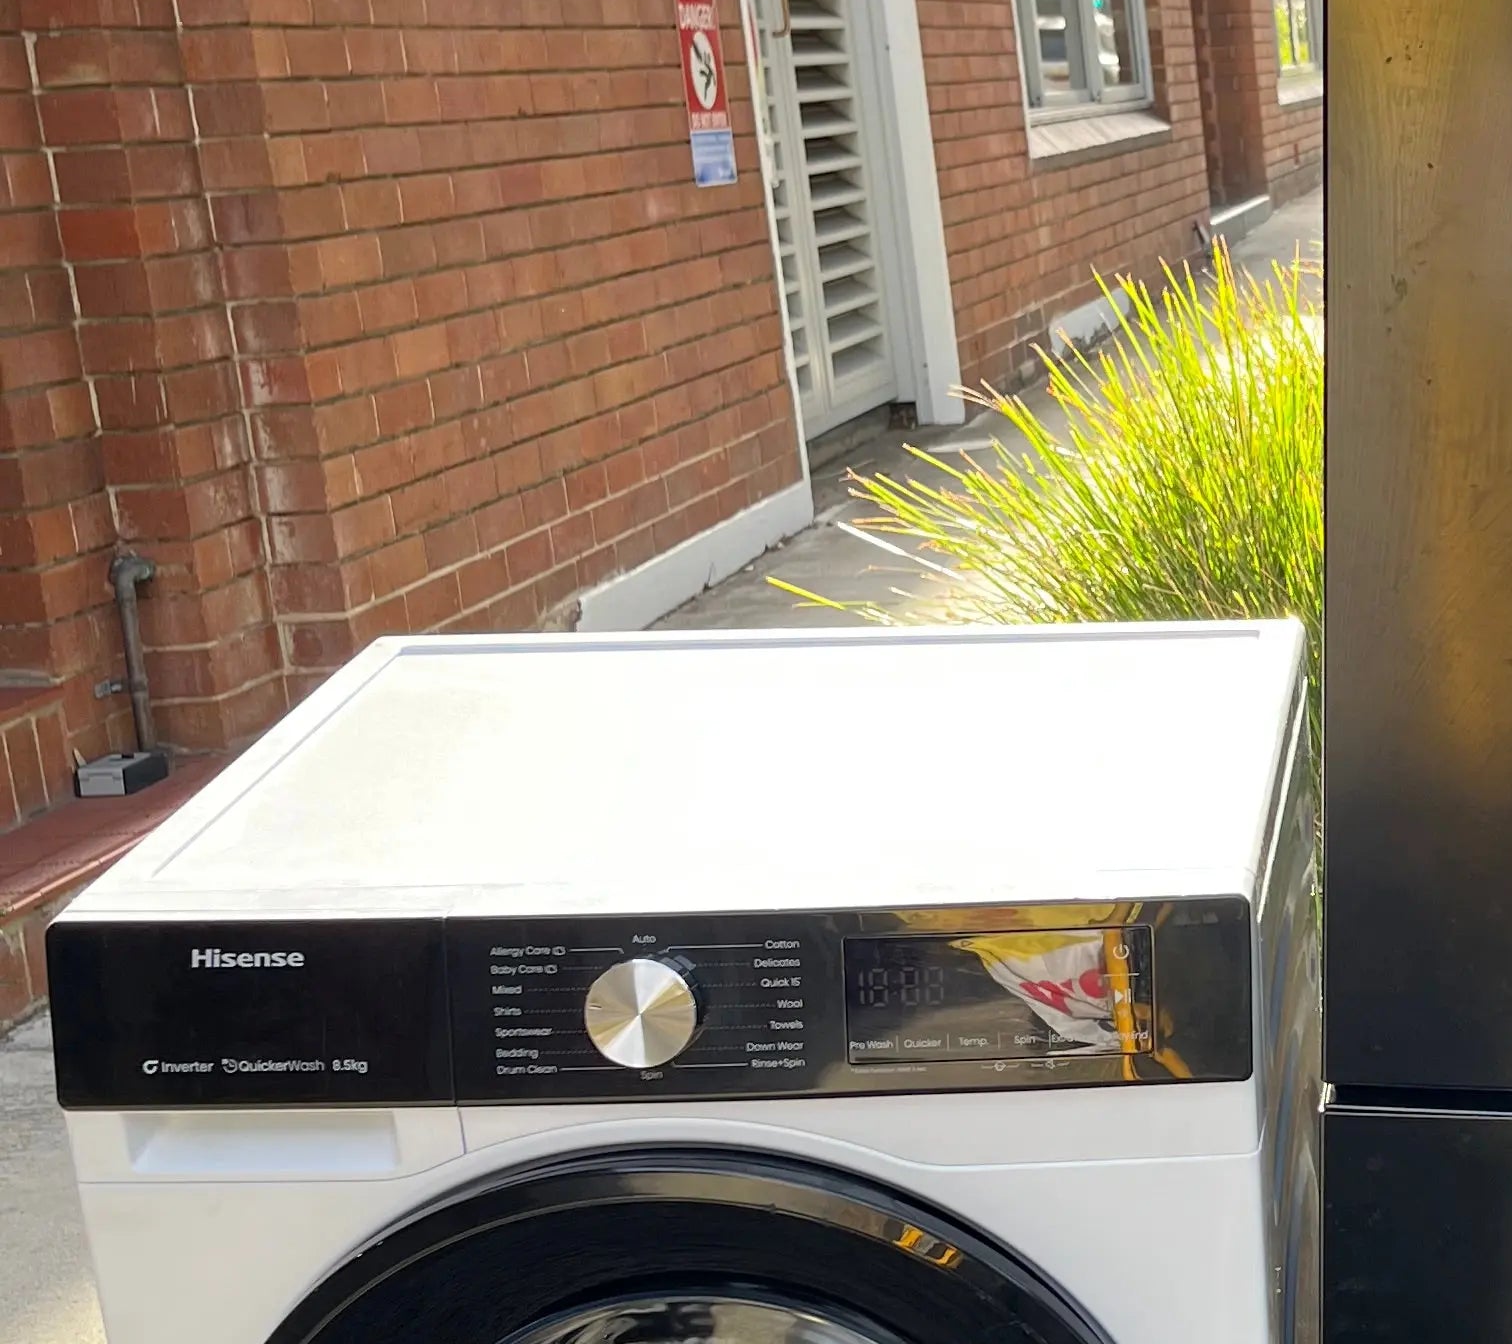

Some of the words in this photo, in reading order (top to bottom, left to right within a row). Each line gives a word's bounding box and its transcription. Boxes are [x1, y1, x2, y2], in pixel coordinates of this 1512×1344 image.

[632, 934, 657, 944] Auto
[764, 940, 800, 949] Cotton
[191, 948, 305, 969] Hisense
[760, 977, 790, 987] Quick
[776, 998, 804, 1009] Wool
[867, 1038, 894, 1049] Wash
[903, 1038, 942, 1049] Quicker
[1014, 1034, 1037, 1046] Spin
[746, 1042, 776, 1052] Down
[777, 1041, 805, 1051] Wear
[161, 1060, 215, 1073] Inverter
[238, 1060, 326, 1073] QuickerWash
